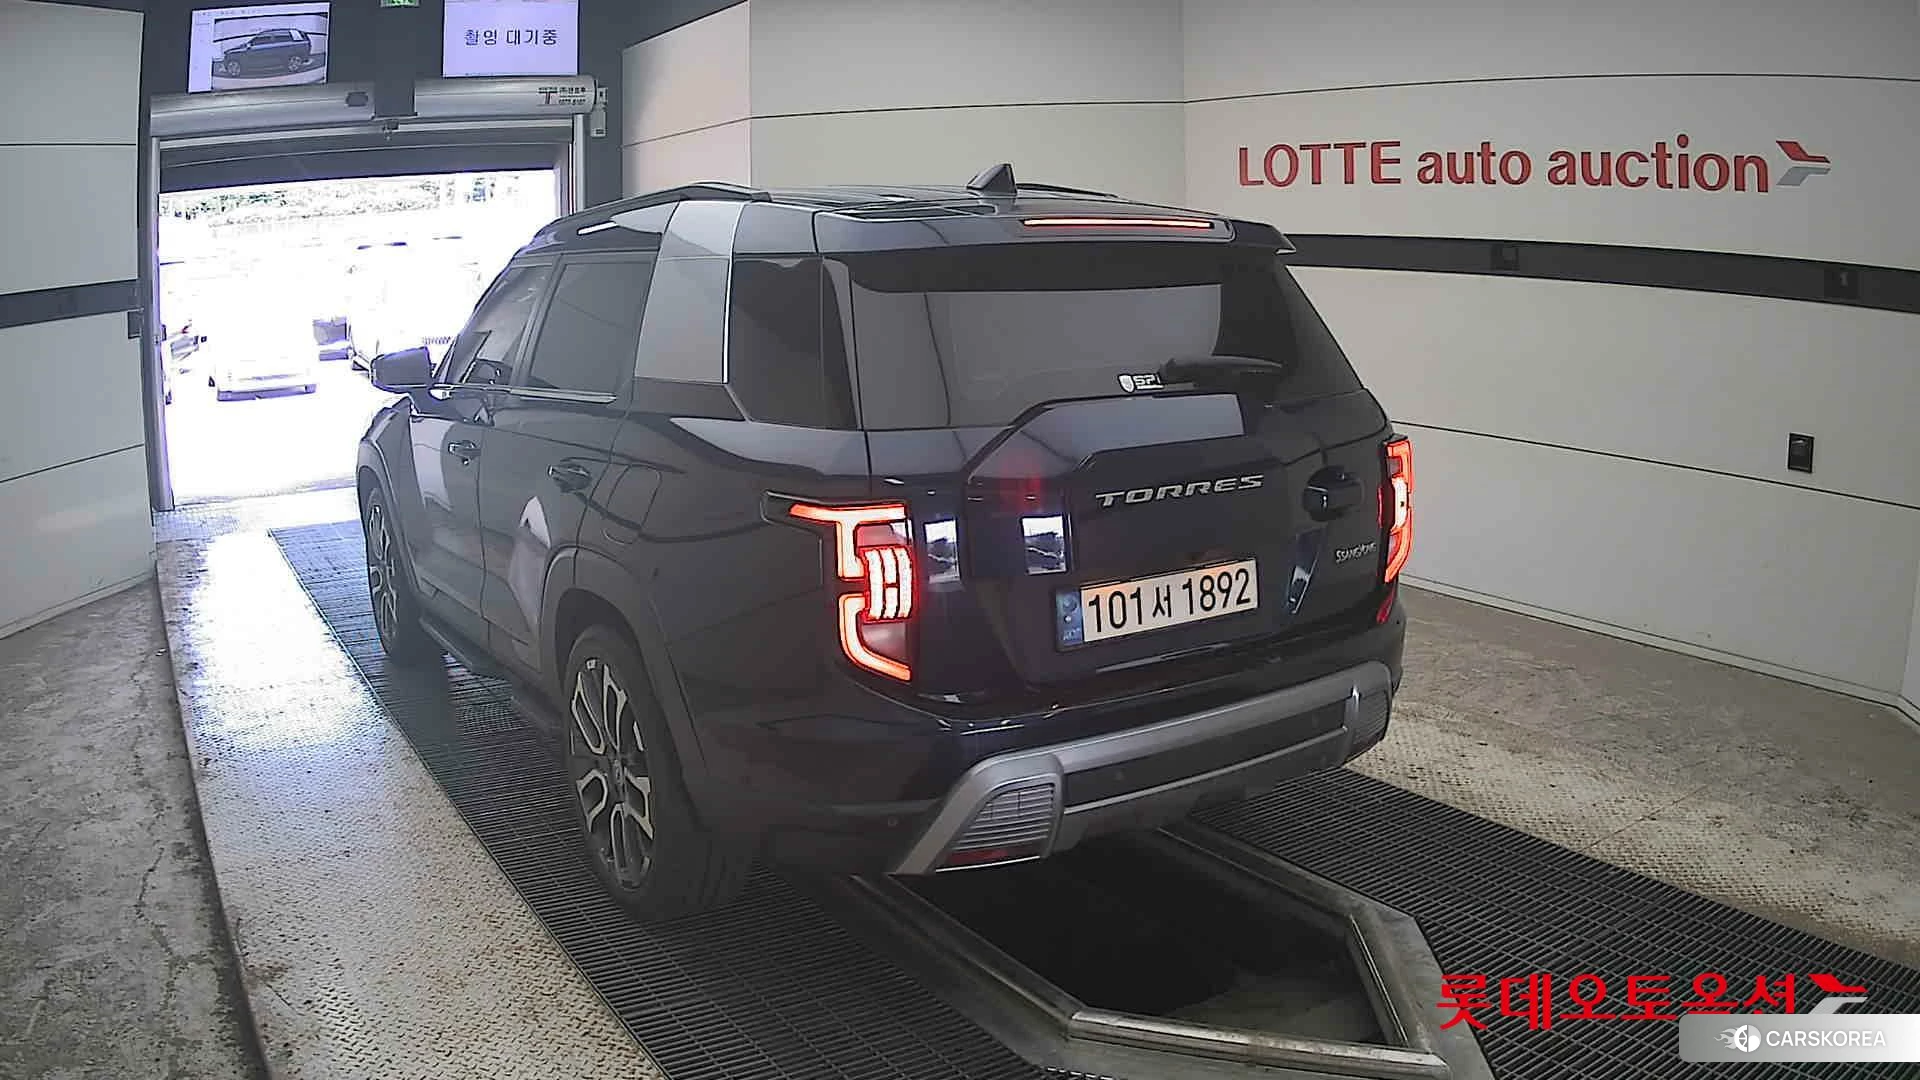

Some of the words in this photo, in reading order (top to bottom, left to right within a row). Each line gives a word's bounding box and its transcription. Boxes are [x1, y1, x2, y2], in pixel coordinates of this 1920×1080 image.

[506, 29, 558, 46] 대기중
[1239, 141, 1401, 187] LOTTE
[1417, 141, 1531, 185] auto
[1547, 134, 1770, 193] auction
[1096, 475, 1264, 507] TORRES
